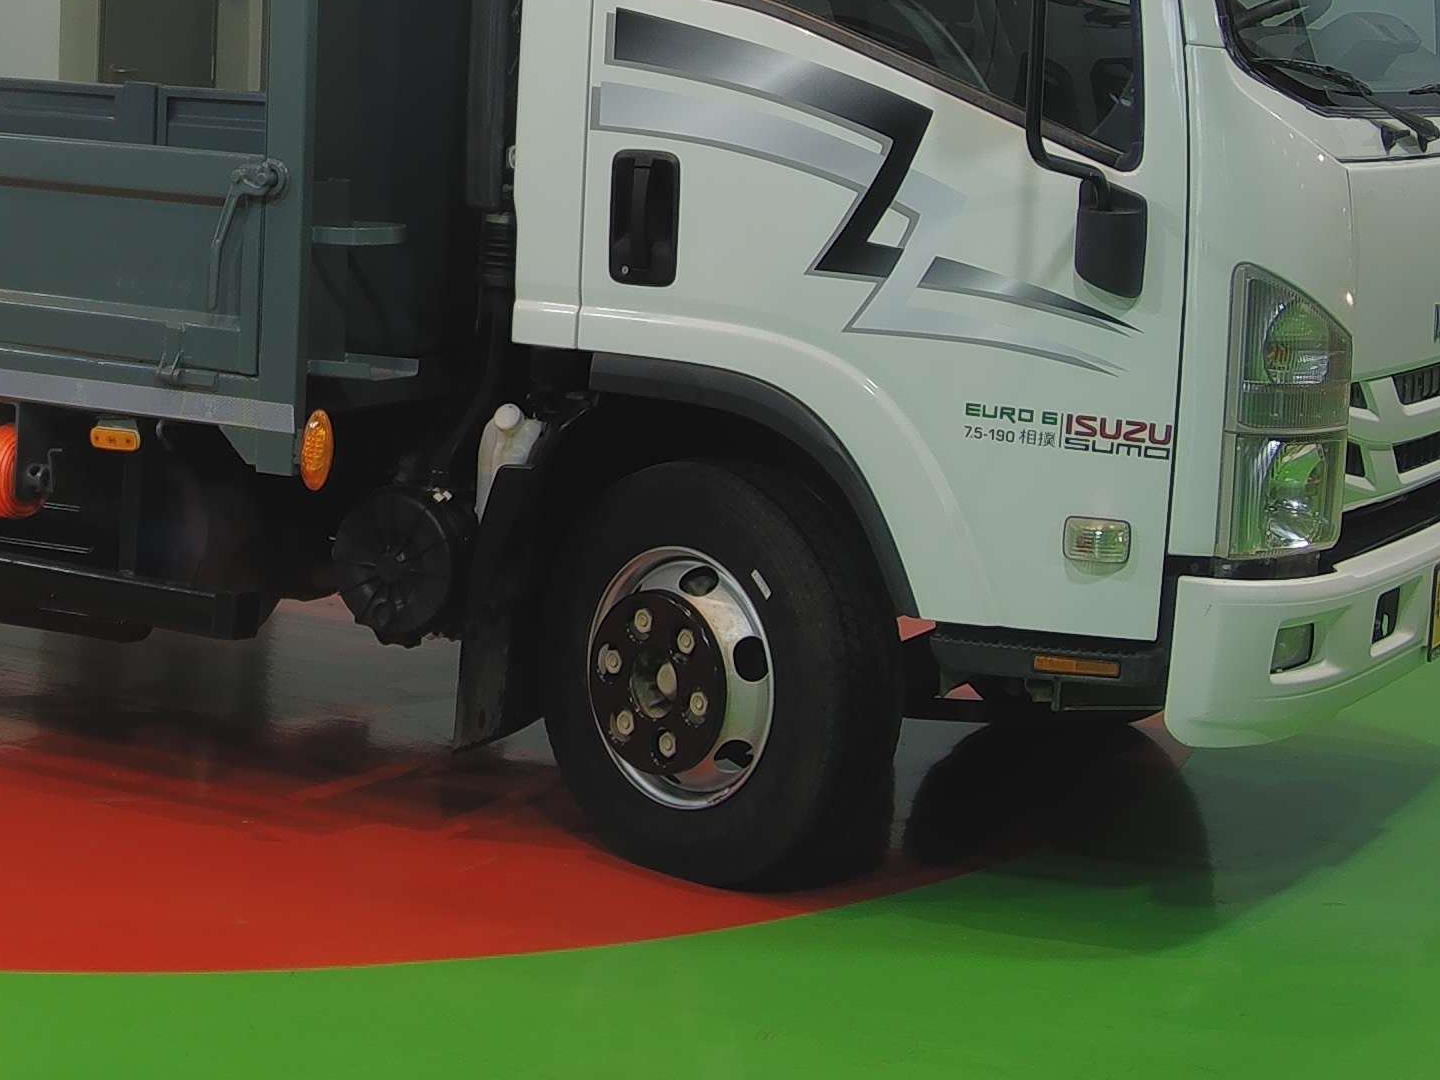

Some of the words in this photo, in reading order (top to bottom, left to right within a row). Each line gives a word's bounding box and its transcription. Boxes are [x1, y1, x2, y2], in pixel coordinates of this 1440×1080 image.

[965, 402, 1034, 424] EURO
[1041, 411, 1058, 426] 6
[1065, 413, 1173, 446] ISUZU
[1064, 437, 1171, 461] SUMO
